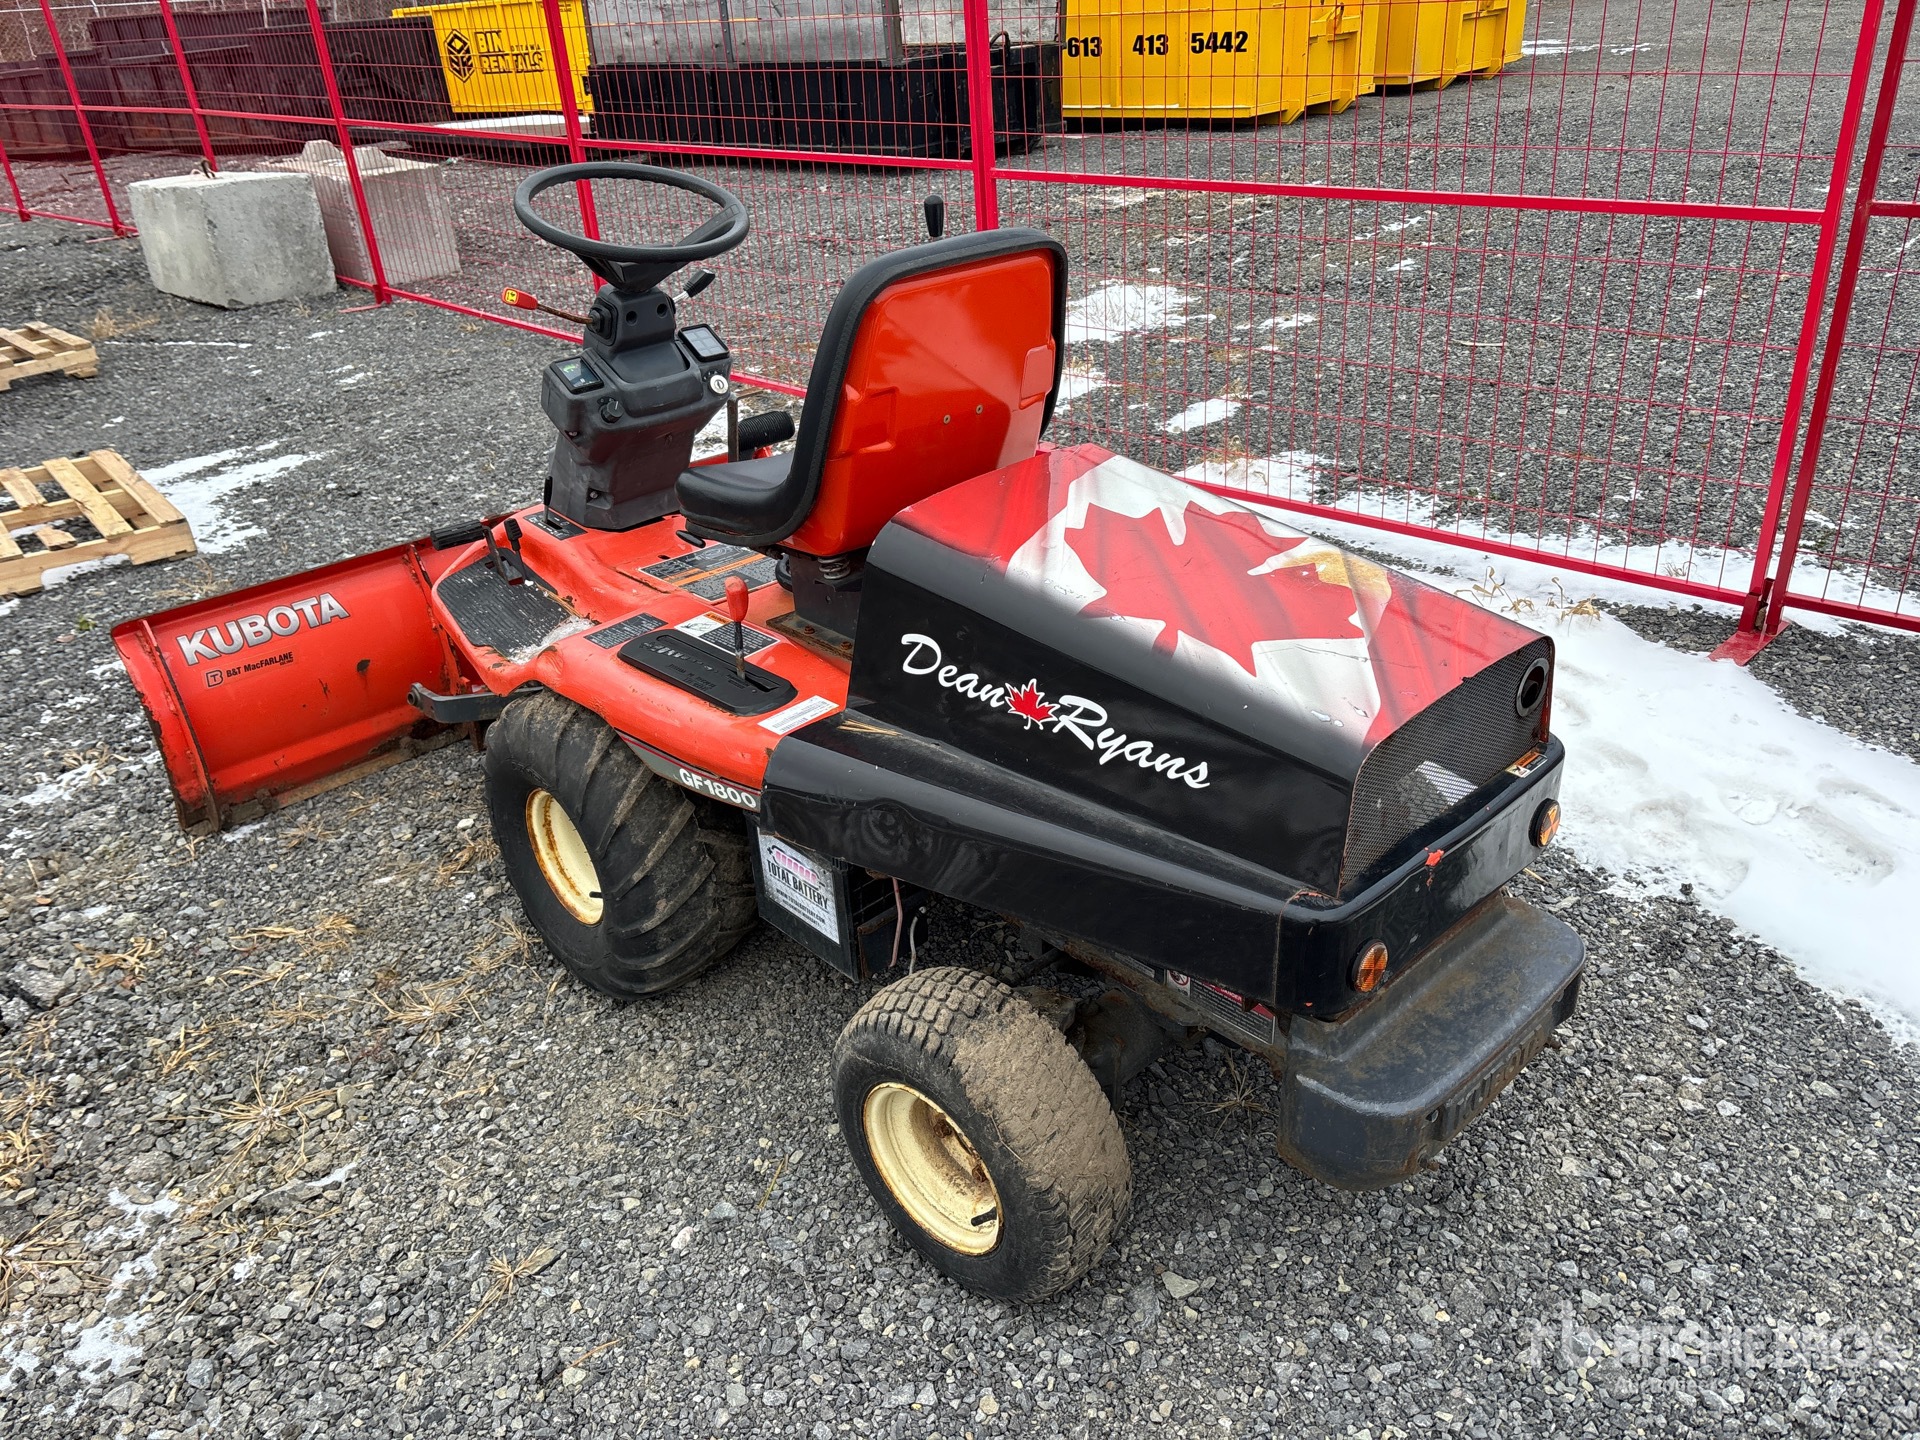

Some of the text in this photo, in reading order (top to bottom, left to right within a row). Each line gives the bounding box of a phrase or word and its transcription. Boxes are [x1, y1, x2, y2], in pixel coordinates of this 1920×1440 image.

[474, 30, 505, 53] BIN
[1067, 30, 1249, 58] 613 413 5442
[479, 51, 544, 75] RENTALS
[176, 592, 350, 666] KUBOTA
[226, 666, 242, 678] B&T
[243, 651, 294, 673] MacFARLANE
[901, 633, 1210, 789] Dean Ryans
[679, 768, 757, 808] GF1800
[767, 859, 829, 911] TOTAL BATTERY
